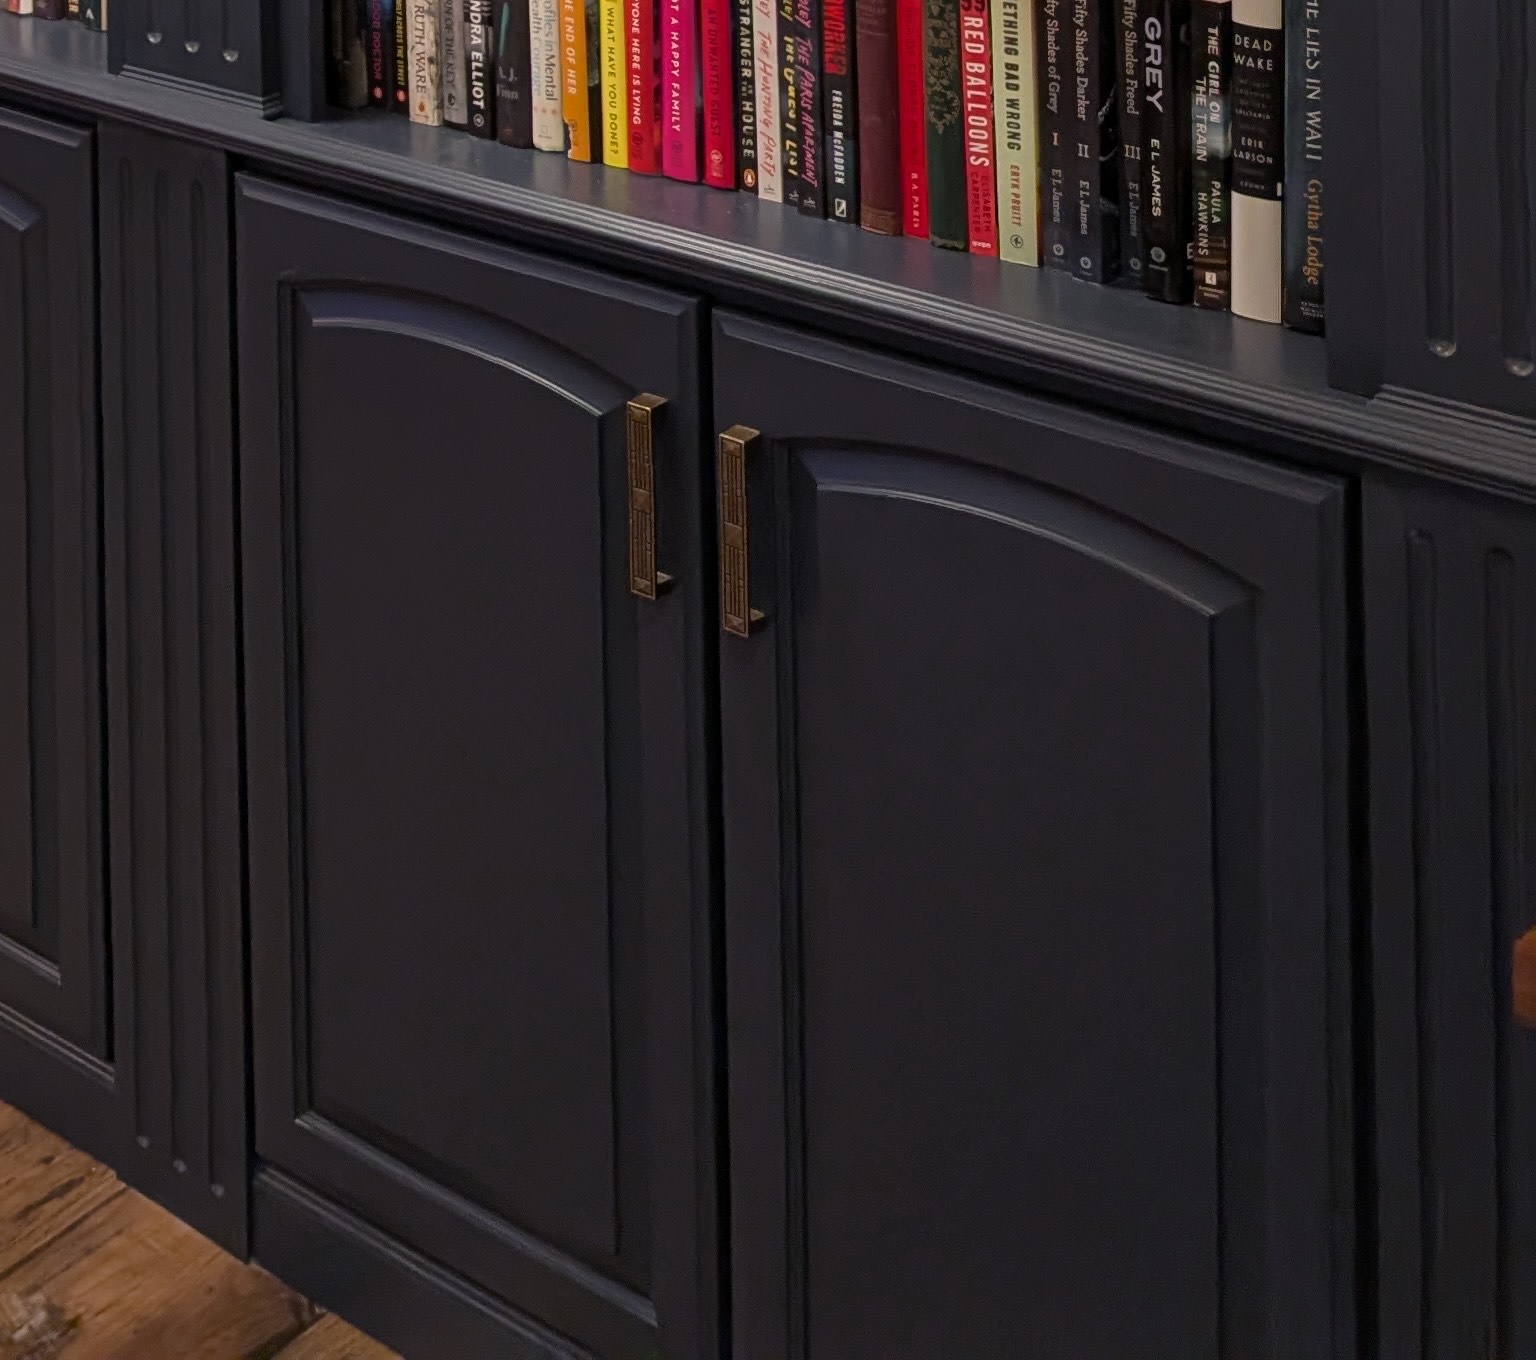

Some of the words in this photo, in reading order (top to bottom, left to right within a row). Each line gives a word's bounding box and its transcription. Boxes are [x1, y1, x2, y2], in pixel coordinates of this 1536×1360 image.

[565, 17, 574, 41] END
[670, 16, 679, 24] A
[1122, 0, 1136, 27] Fifty
[963, 17, 984, 54] RED
[1047, 19, 1060, 62] Shades
[1076, 29, 1088, 74] Shades
[566, 47, 575, 63] OF
[632, 38, 640, 70] HERE
[670, 31, 680, 76] HAPPY
[1145, 17, 1163, 112] GREY
[471, 50, 485, 109] ELLIOT
[566, 69, 577, 94] HER
[632, 75, 641, 84] IS
[1004, 62, 1020, 91] BAD
[1048, 66, 1060, 78] of
[632, 90, 641, 124] LYING
[671, 82, 680, 132] FAMILY
[966, 61, 989, 166] BALLOONS
[1047, 82, 1060, 113] Grey
[1077, 76, 1088, 120] Darker
[1006, 98, 1022, 150] WRONG
[1151, 165, 1162, 216] JAMES
